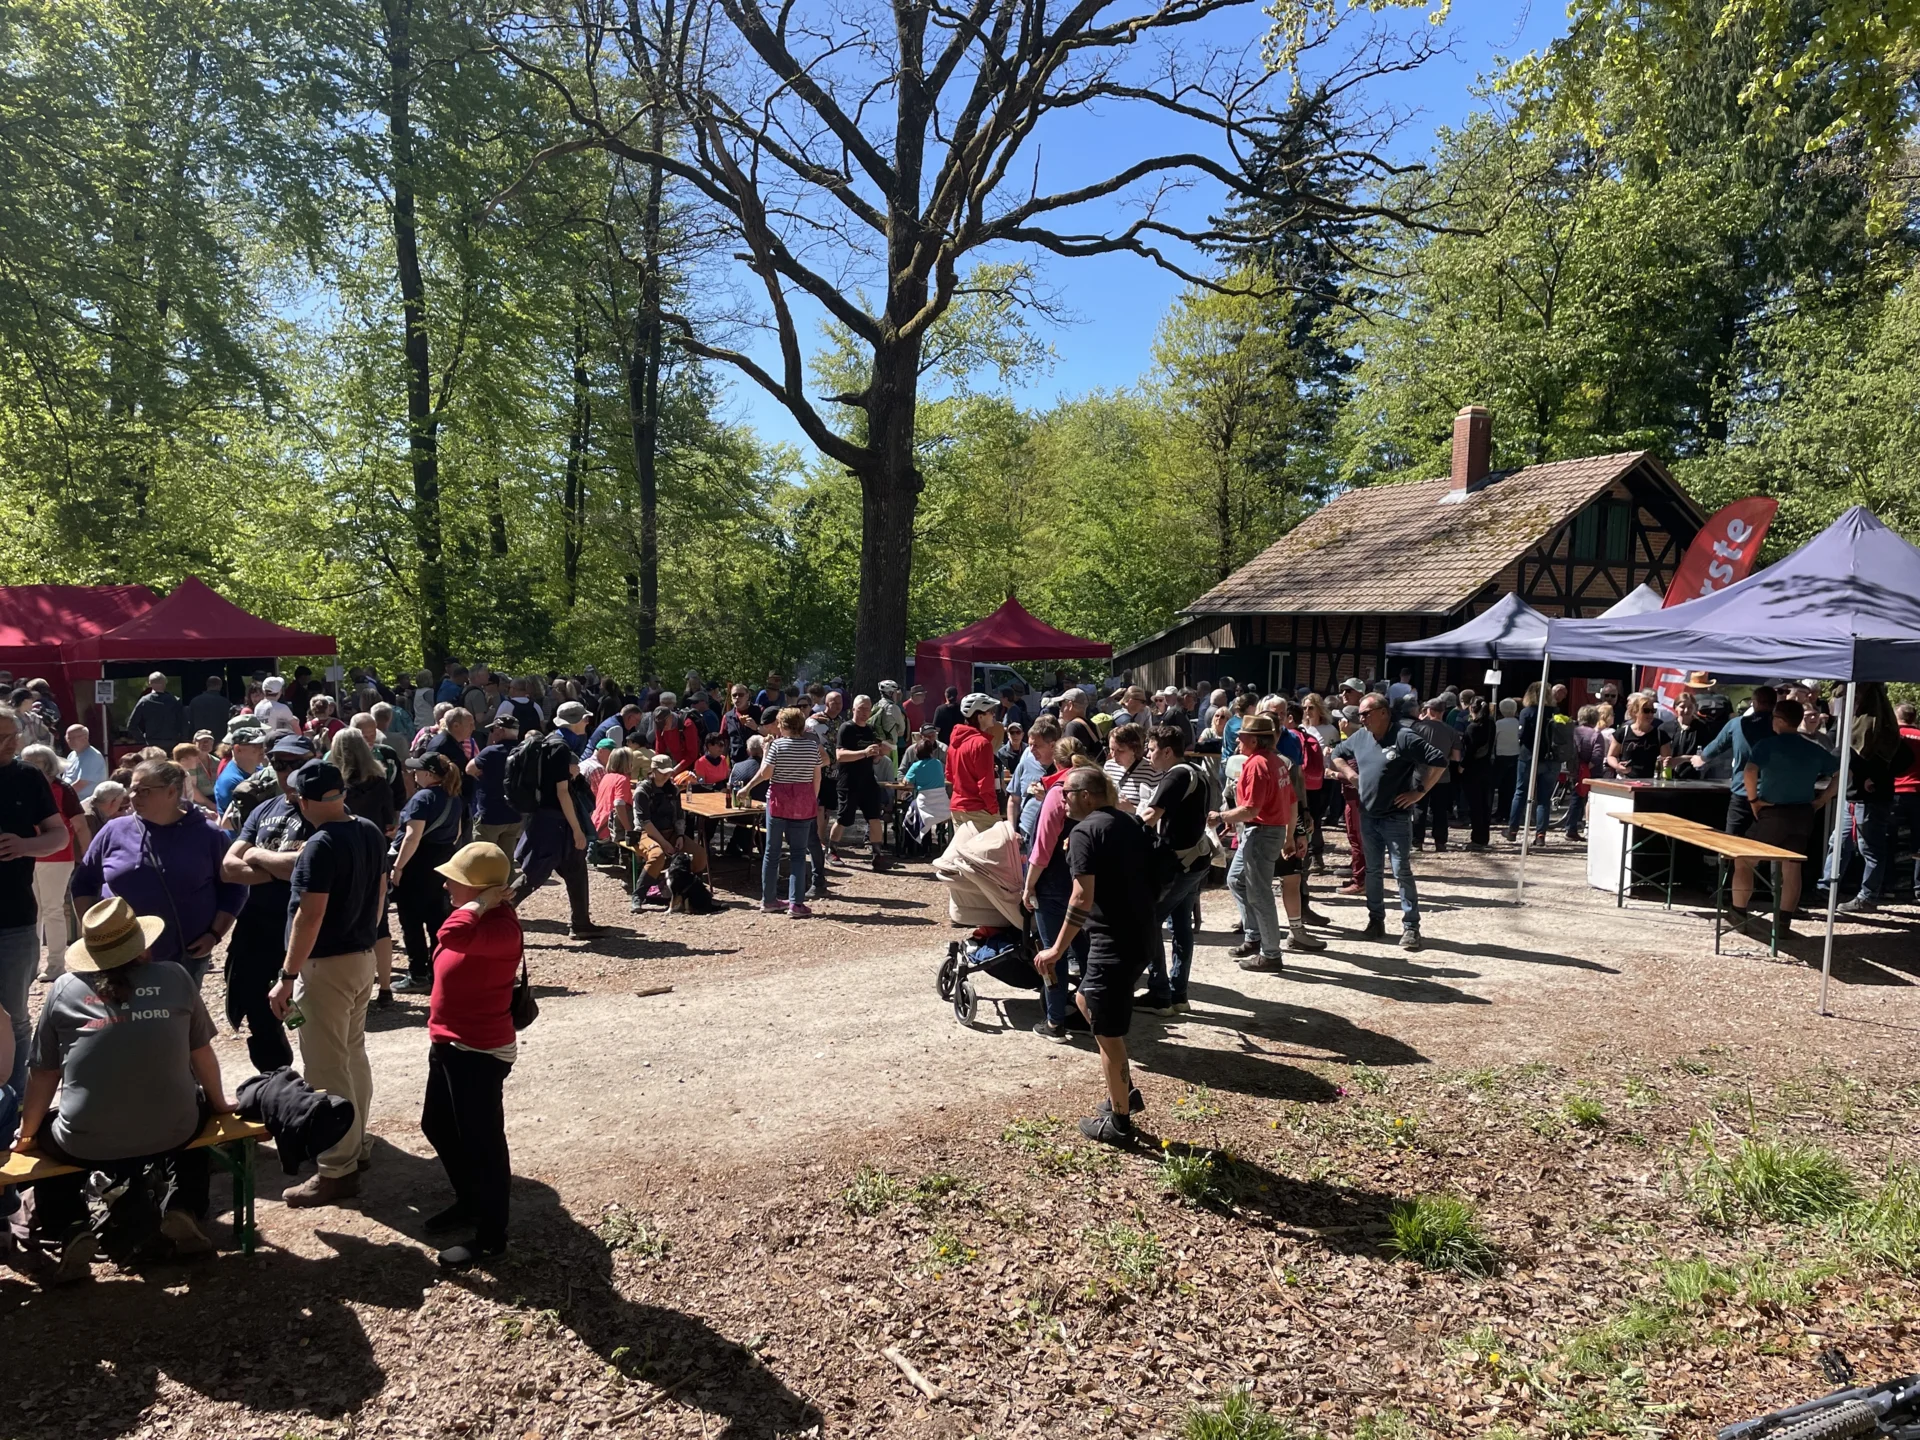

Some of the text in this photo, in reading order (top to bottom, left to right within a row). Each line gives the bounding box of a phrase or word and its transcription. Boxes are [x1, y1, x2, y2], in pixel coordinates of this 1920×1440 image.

[135, 986, 161, 997] OST
[120, 1002, 130, 1010] &
[131, 1008, 170, 1021] NORD
